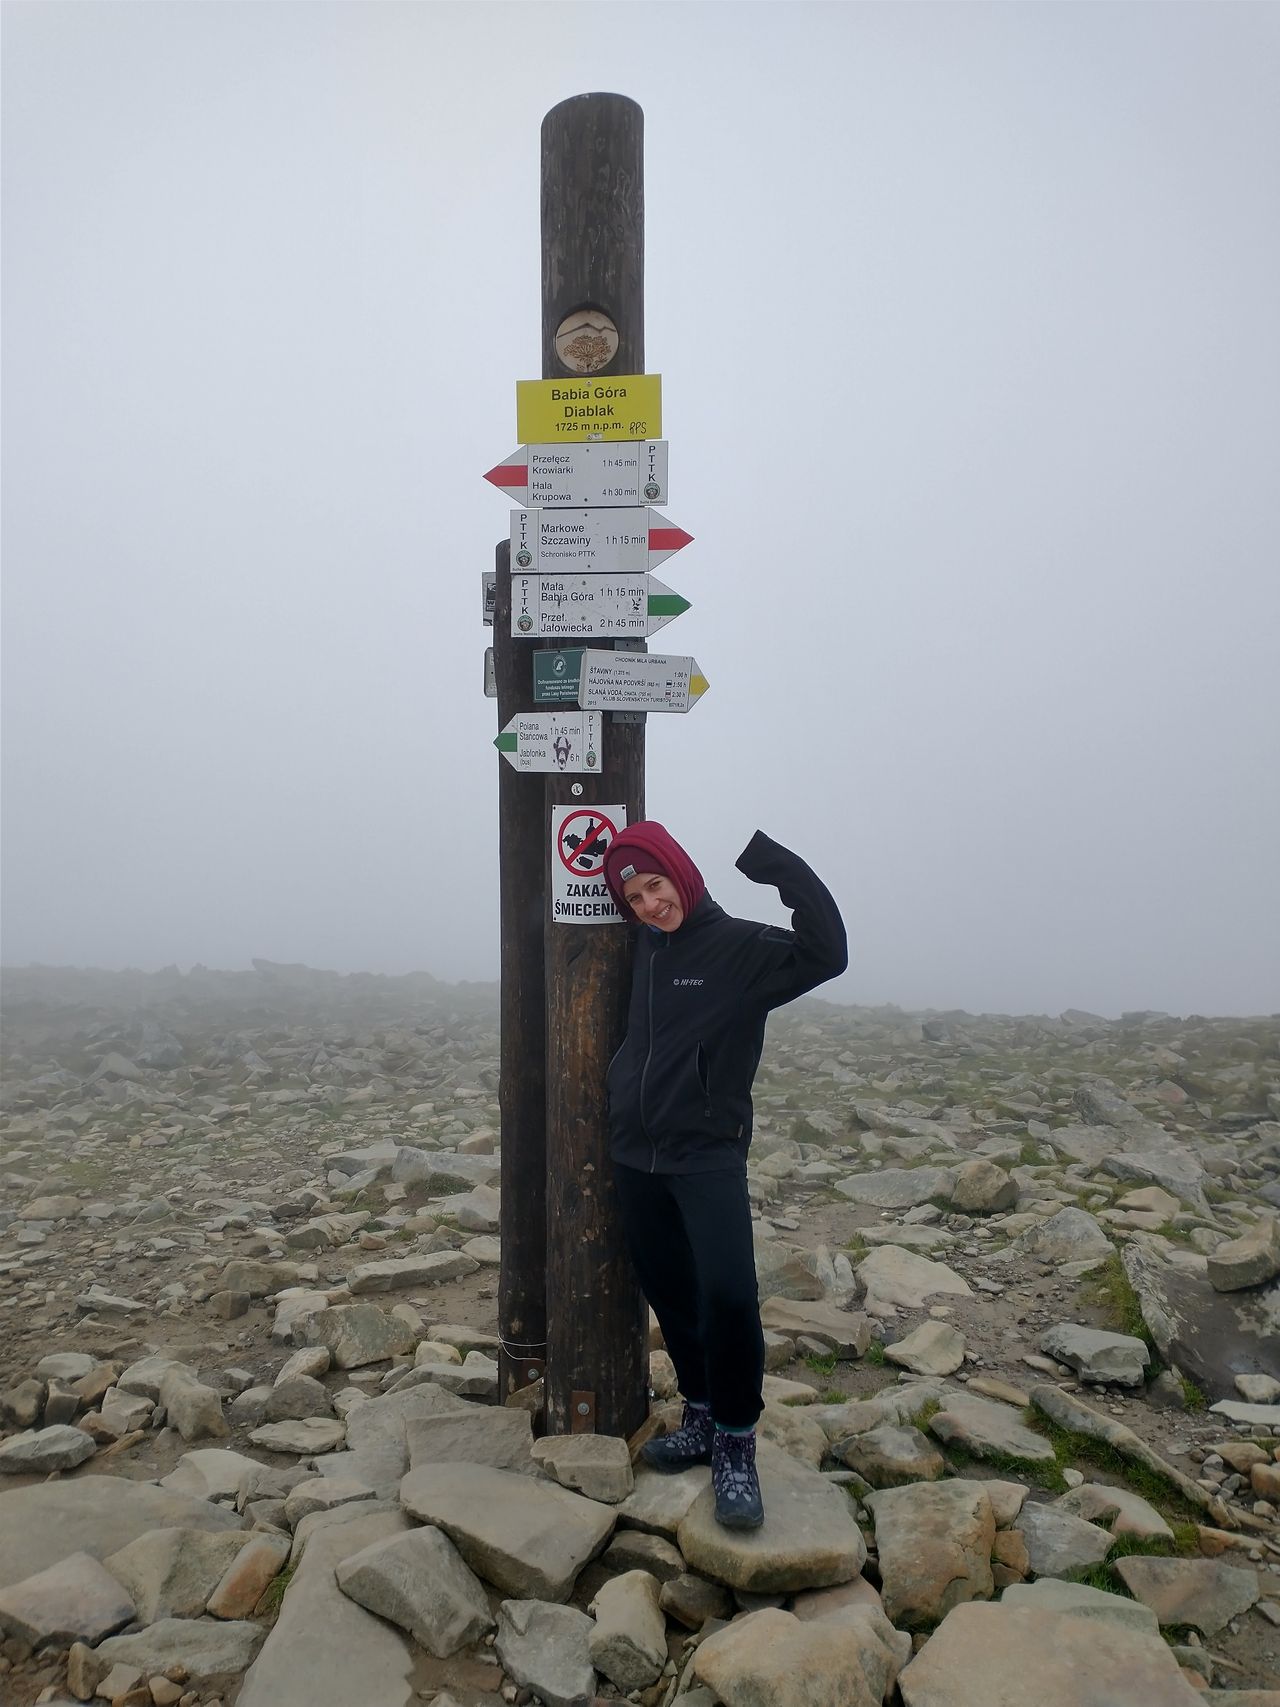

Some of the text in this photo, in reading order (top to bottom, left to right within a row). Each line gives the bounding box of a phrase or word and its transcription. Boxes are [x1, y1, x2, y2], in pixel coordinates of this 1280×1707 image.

[552, 386, 627, 401] Babia Góra
[564, 405, 614, 417] Diablak
[556, 423, 578, 431] 1725
[593, 422, 624, 432] n.p.m.
[532, 455, 570, 464] Przełęcz
[532, 466, 573, 475] Krowiarki
[532, 482, 552, 490] Hala
[532, 493, 572, 502] Krupowa
[542, 524, 584, 533] Markowe
[541, 536, 591, 546] Szczawiny
[620, 536, 629, 544] 15
[632, 536, 646, 544] min
[541, 592, 594, 601] Babia Góra
[629, 588, 644, 596] min
[541, 614, 566, 622] Przeł.
[629, 619, 644, 627] min
[541, 624, 593, 632] Jałowiecka
[520, 722, 539, 730] Polana
[520, 732, 548, 740] Stańcowa
[567, 884, 608, 896] ZAKAZ
